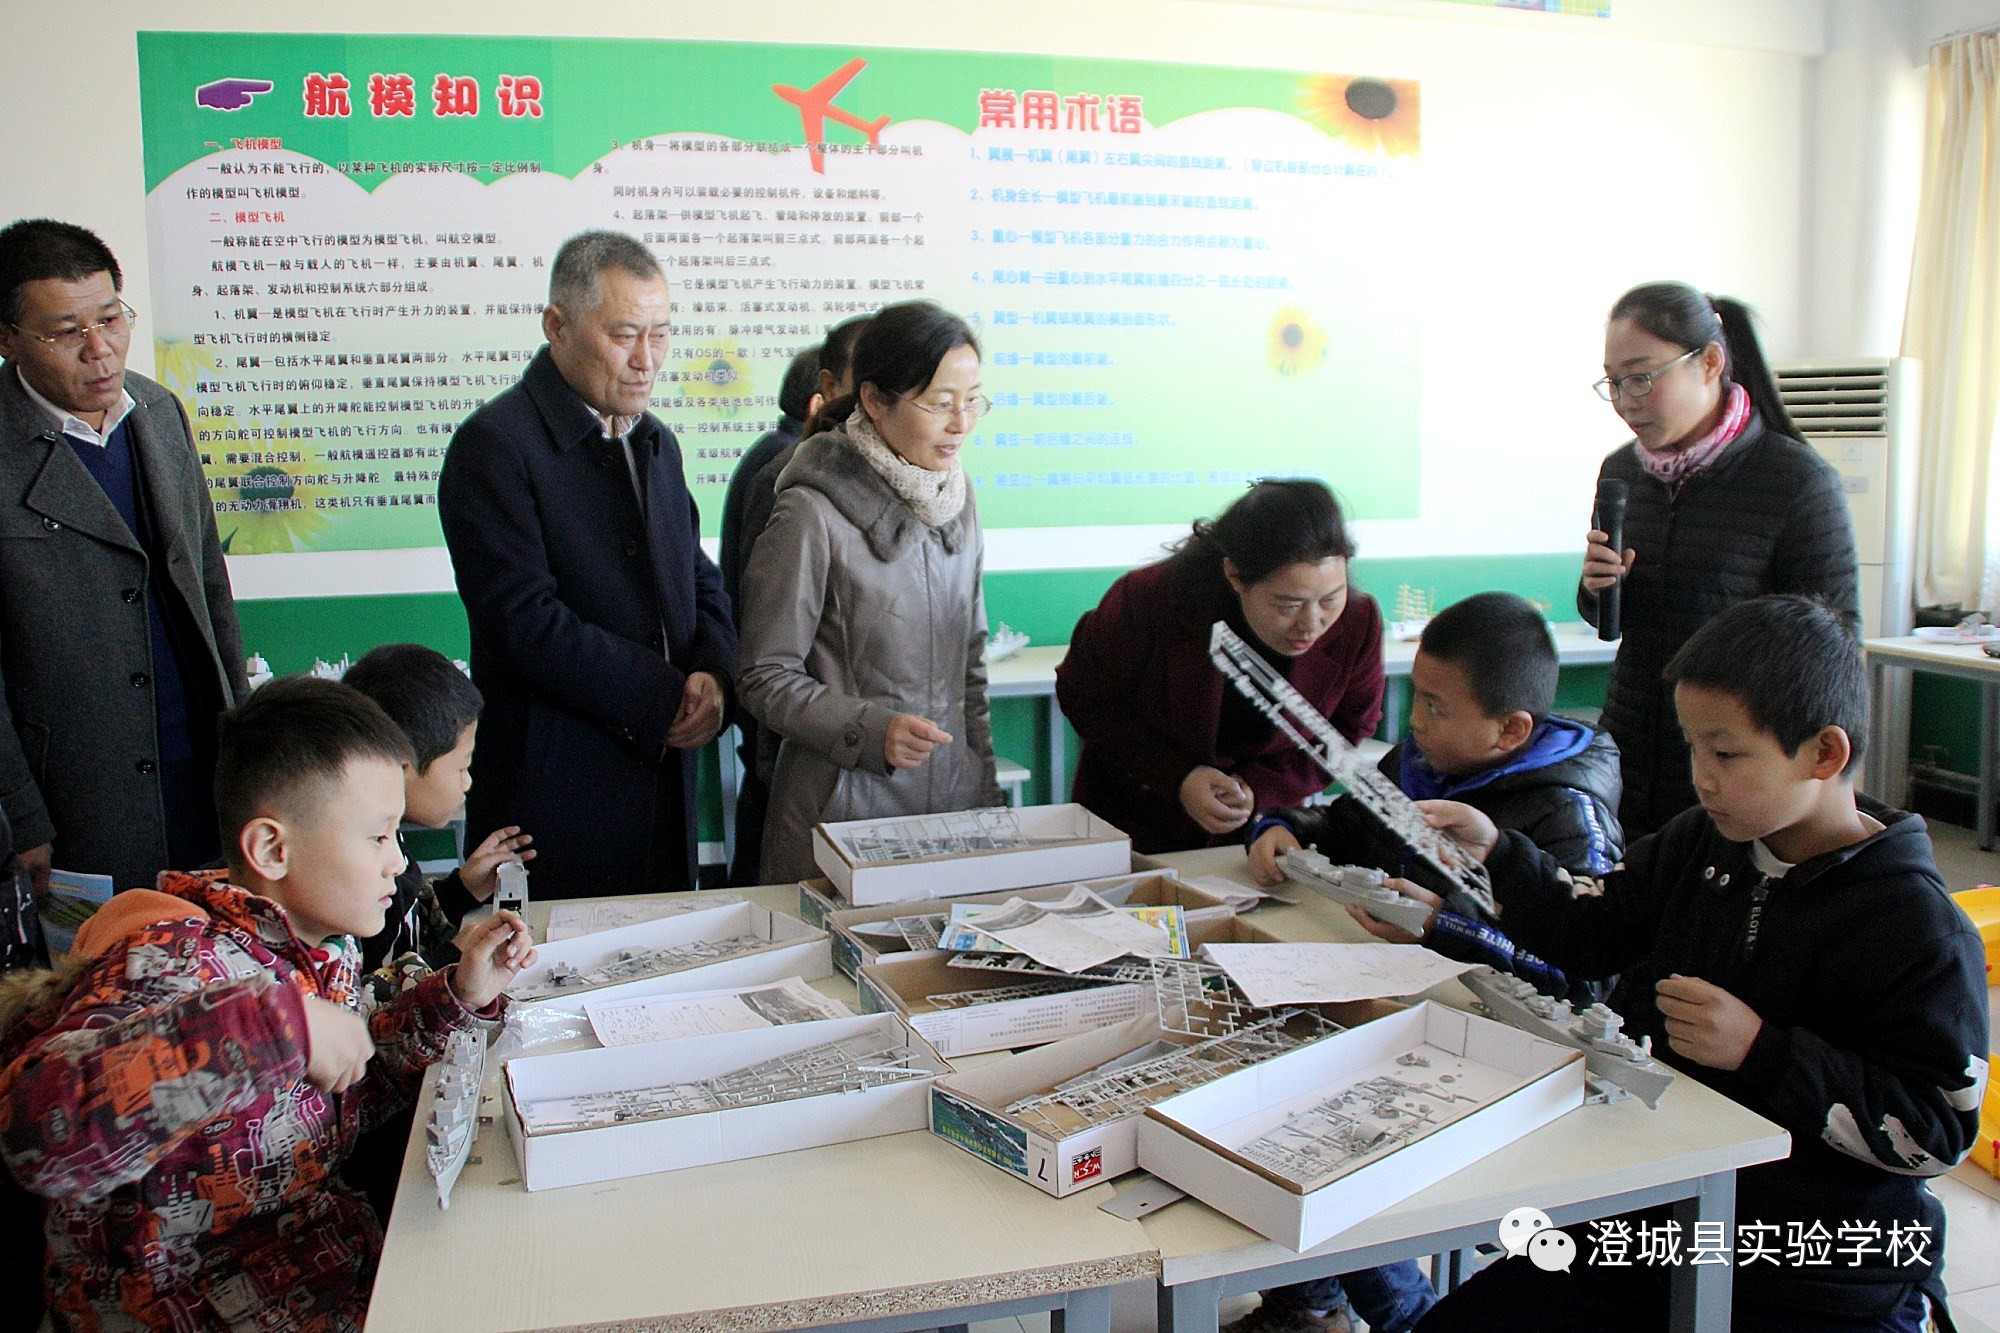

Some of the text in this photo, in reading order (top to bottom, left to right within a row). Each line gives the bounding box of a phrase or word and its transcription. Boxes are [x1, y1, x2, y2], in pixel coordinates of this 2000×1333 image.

[303, 72, 544, 118] 航模知识
[979, 88, 1144, 134] 常用术语
[204, 137, 283, 150] 一、飞机模型
[186, 186, 307, 200] 作的模型叫飞机模型。
[209, 211, 286, 224] 二、模型飞机
